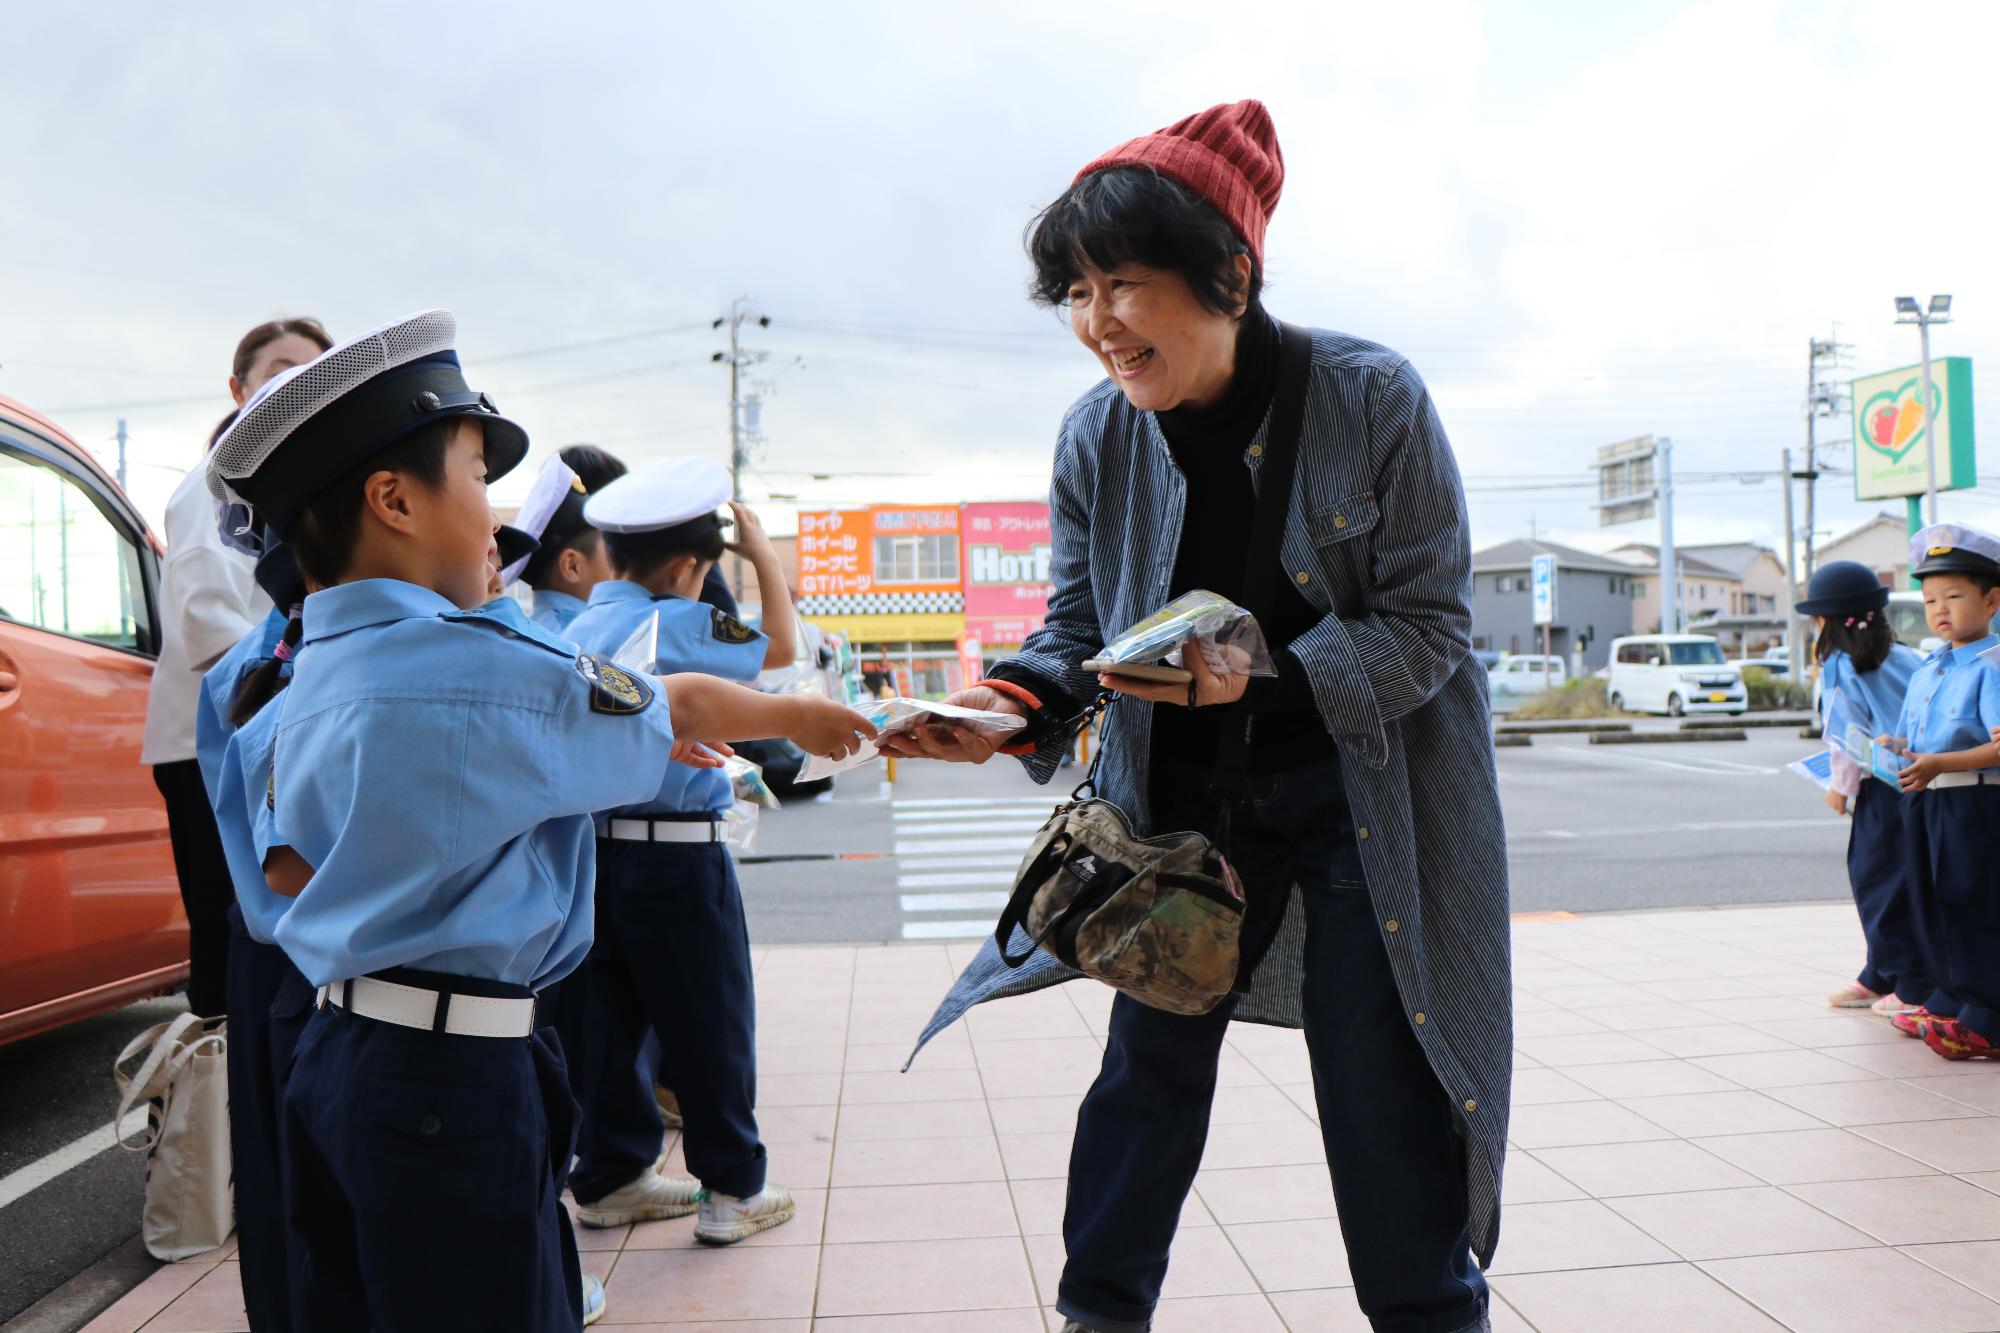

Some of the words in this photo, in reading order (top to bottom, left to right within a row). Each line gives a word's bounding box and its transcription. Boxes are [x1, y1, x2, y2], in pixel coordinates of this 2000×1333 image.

[802, 535, 857, 551] ホイール
[802, 554, 857, 571] カーナビ
[802, 575, 871, 592] GTパーツ
